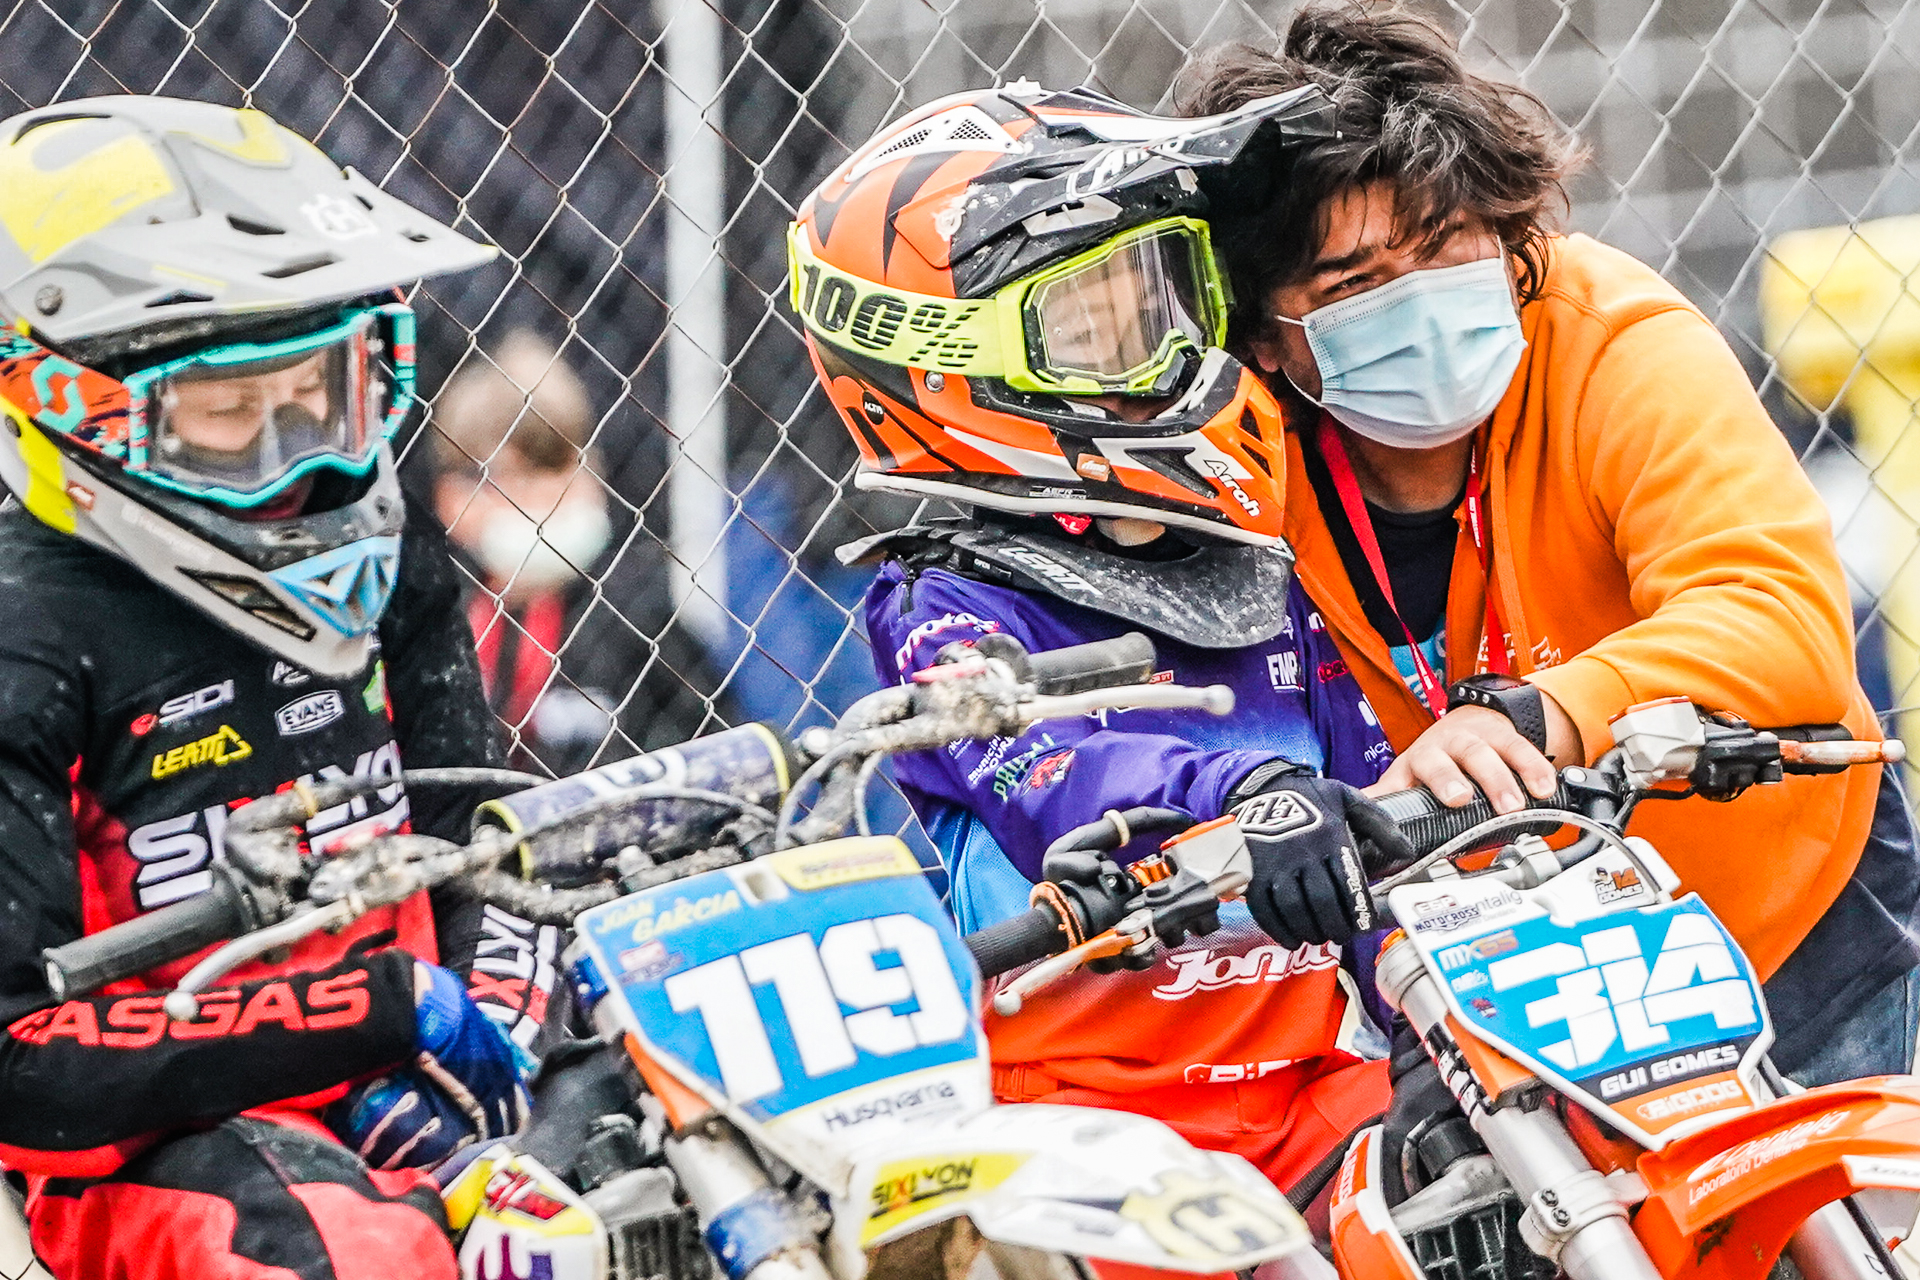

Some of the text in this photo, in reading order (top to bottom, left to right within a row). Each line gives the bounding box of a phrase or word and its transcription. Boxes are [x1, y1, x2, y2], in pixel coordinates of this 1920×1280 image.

[803, 264, 979, 369] 100%
[1203, 460, 1261, 517] Airoh
[284, 701, 335, 727] EVANS
[1414, 906, 1480, 931] MOTOCROSS
[664, 913, 970, 1105] 119
[1488, 912, 1758, 1071] 314
[1600, 1044, 1740, 1099] GUI GOMES
[822, 1082, 956, 1132] Husqvarna
